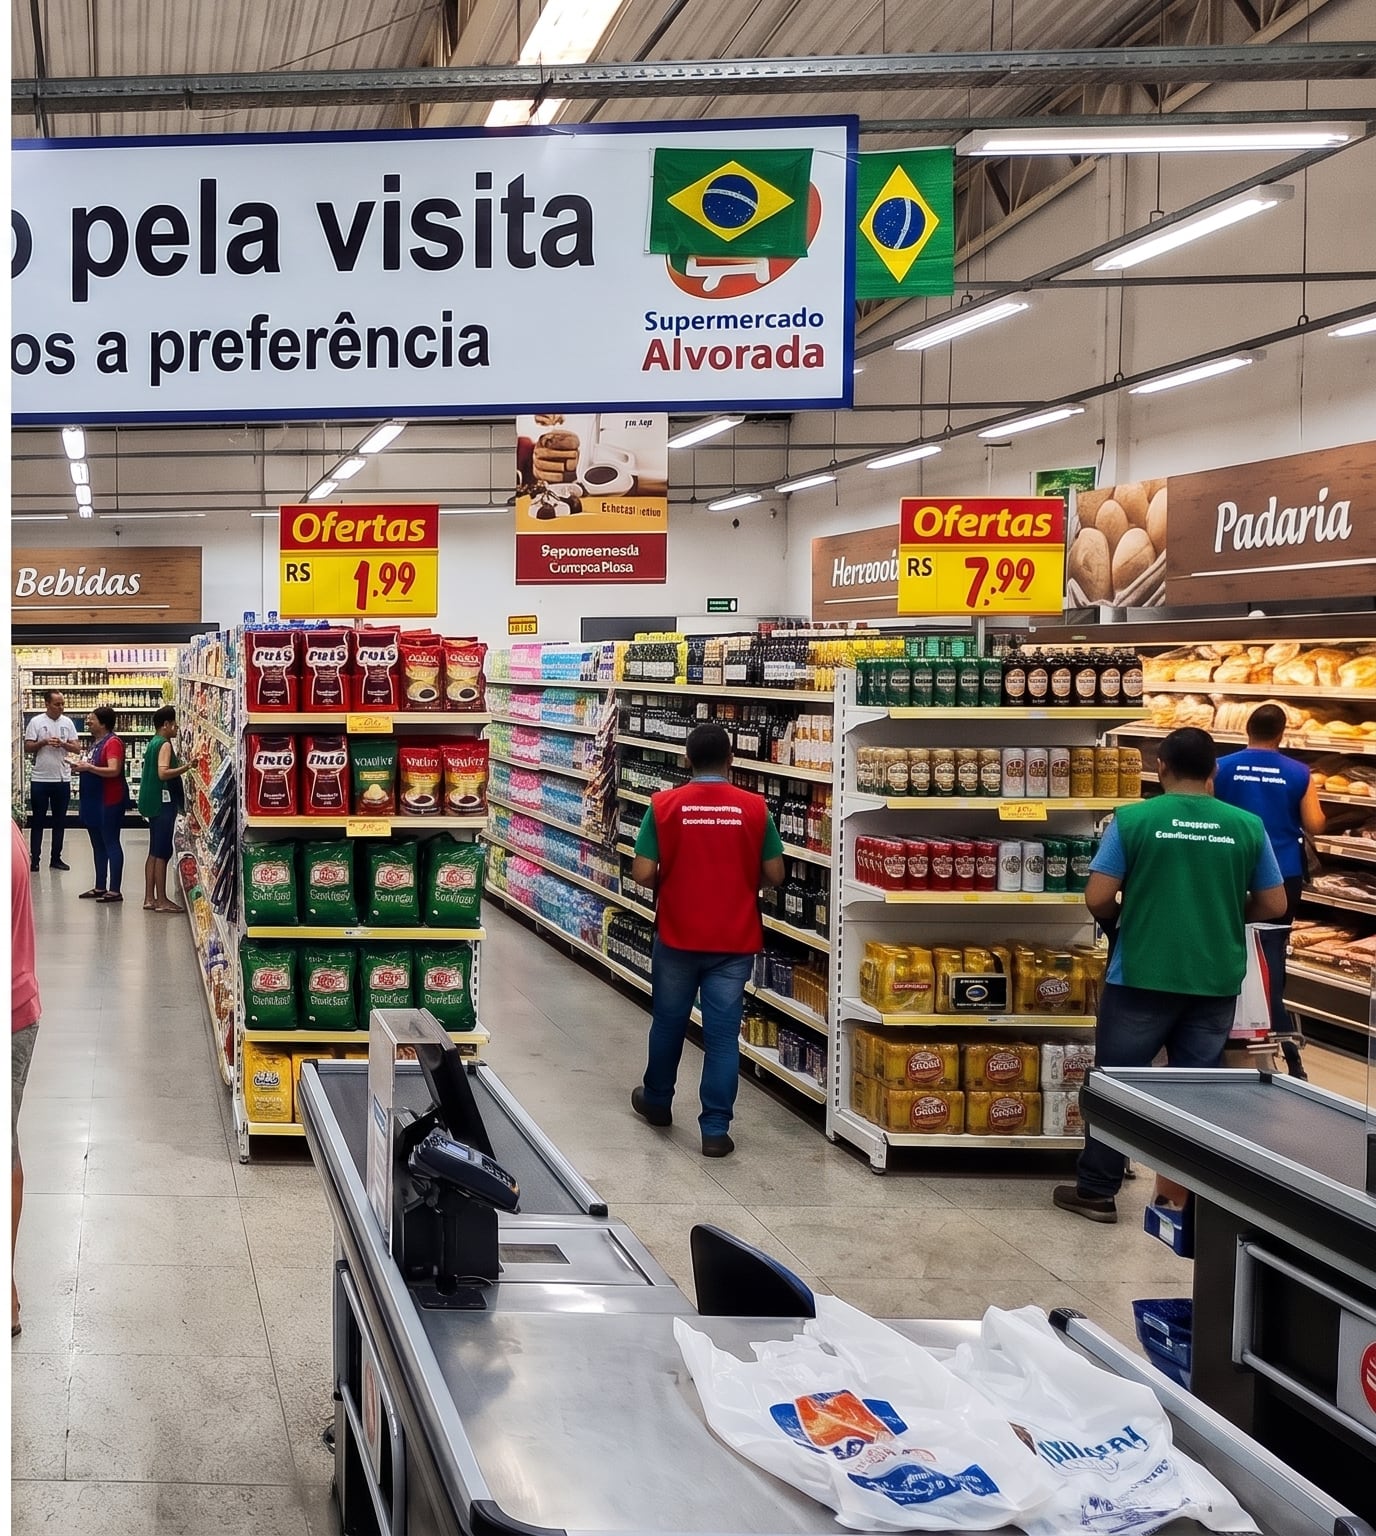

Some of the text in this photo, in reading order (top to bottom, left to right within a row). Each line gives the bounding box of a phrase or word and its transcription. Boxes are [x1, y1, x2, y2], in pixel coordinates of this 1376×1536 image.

[72, 178, 280, 303] pela
[316, 172, 595, 272] visita
[644, 306, 824, 337] Supermercado
[11, 310, 490, 387] os a preferência
[641, 334, 824, 371] Alvorada
[291, 511, 426, 543] Ofertas
[913, 504, 1052, 538] Ofertas
[1214, 487, 1353, 553] Padaria
[15, 566, 141, 597] Bebidas
